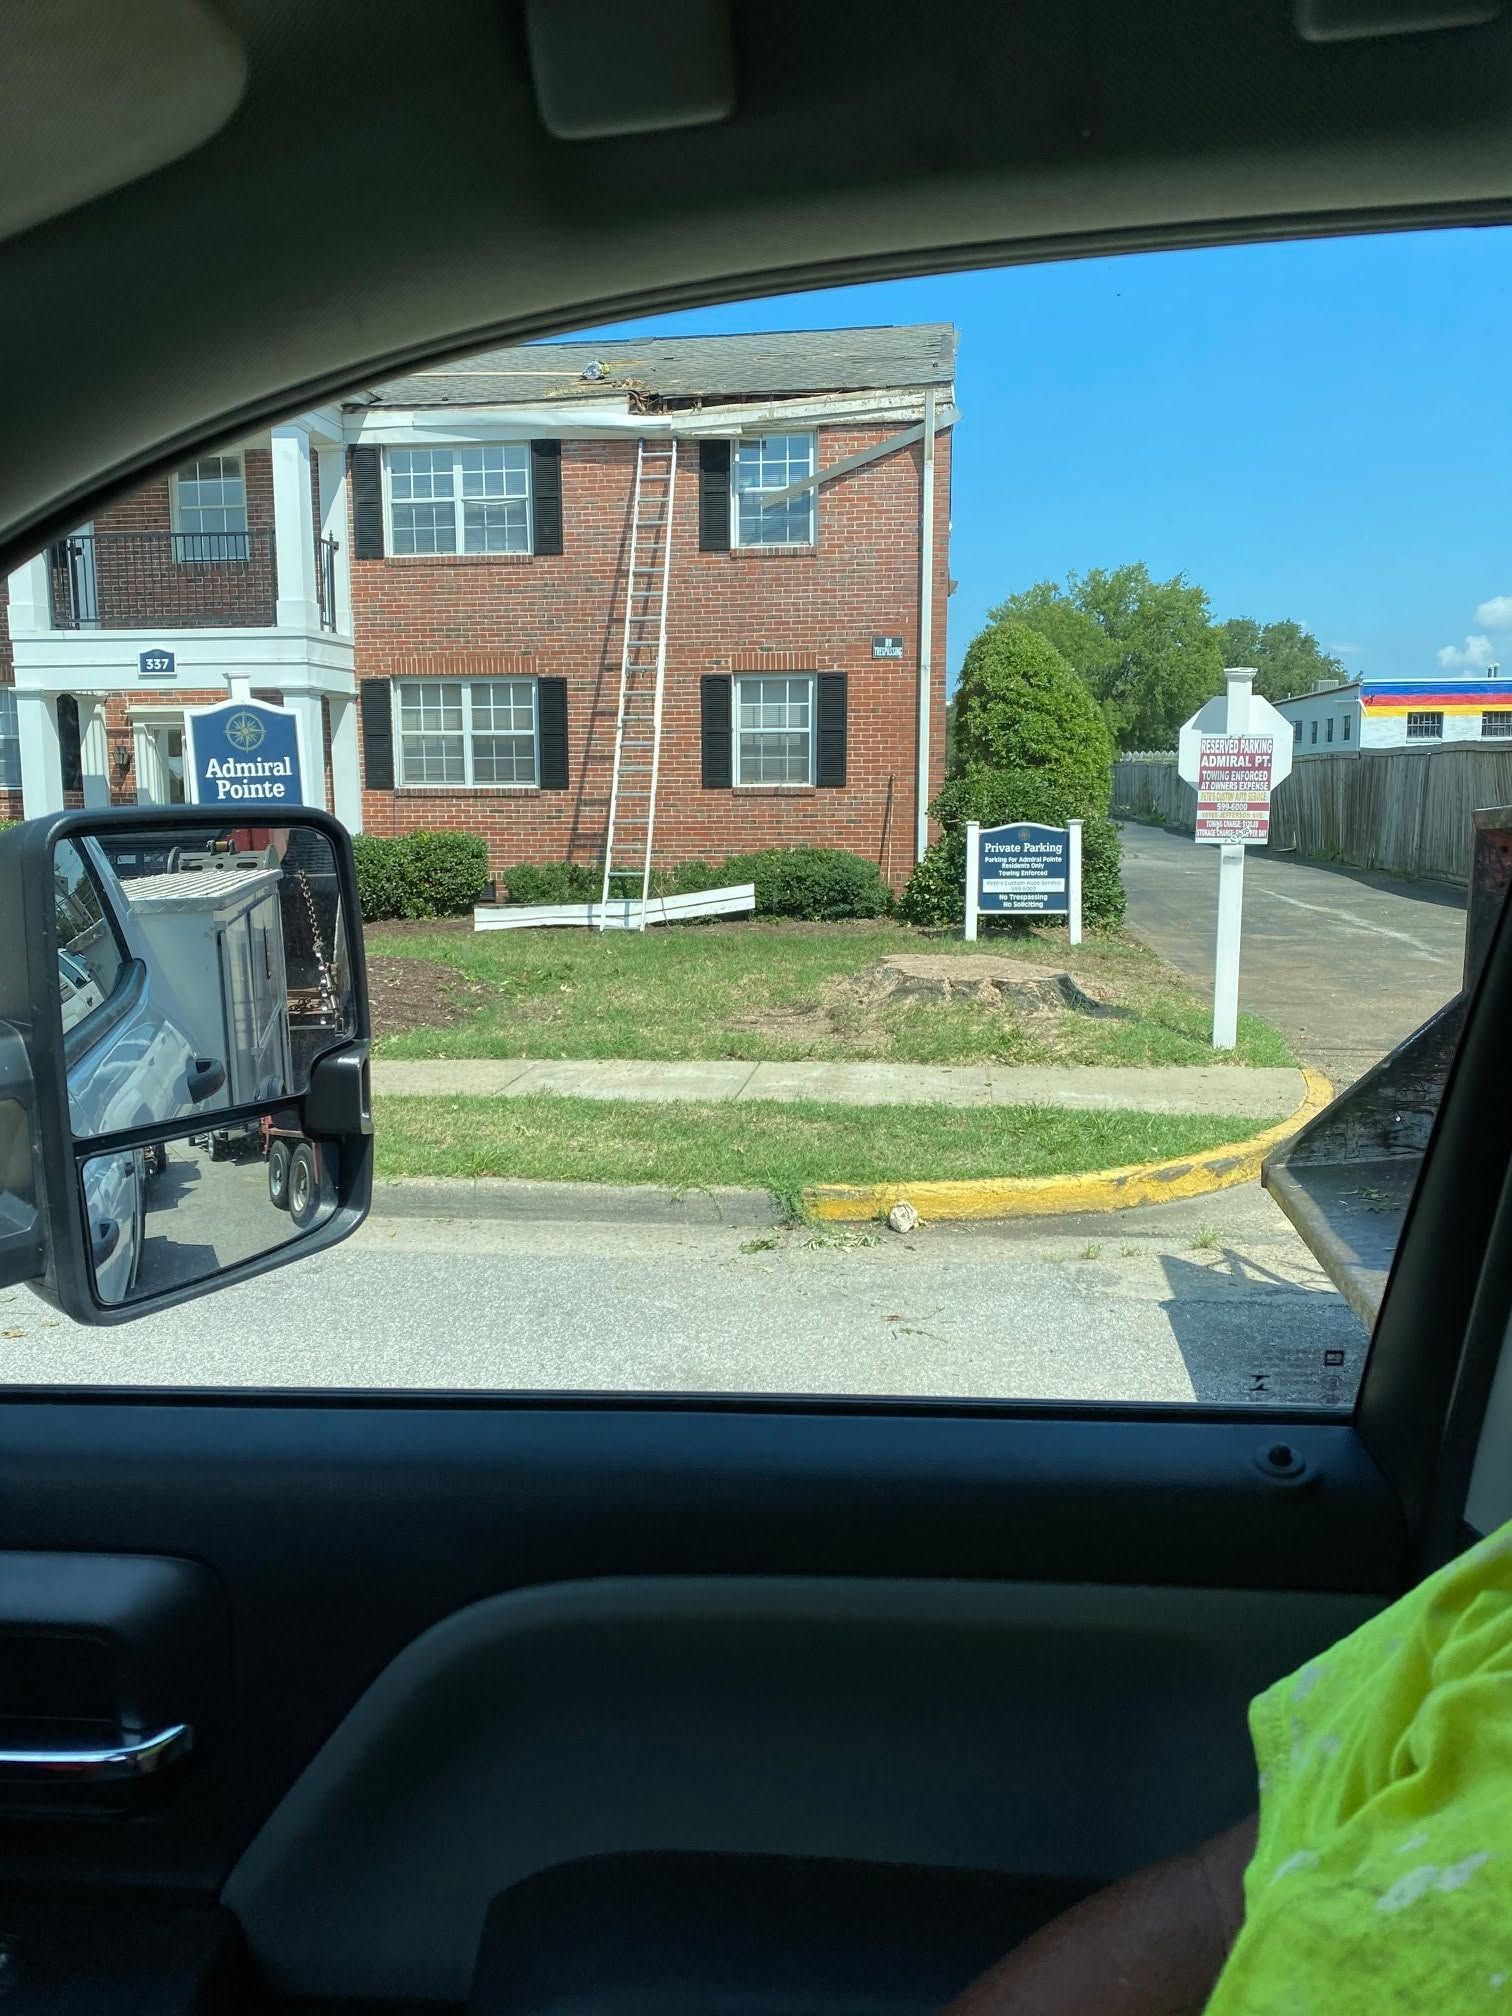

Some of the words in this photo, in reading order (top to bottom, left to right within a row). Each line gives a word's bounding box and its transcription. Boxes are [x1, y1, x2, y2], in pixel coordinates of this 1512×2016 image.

[145, 658, 169, 670] 337
[1201, 739, 1239, 754] RESERVED
[1240, 739, 1273, 754] PARKING
[205, 757, 292, 778] Admiral
[1201, 755, 1252, 768] ADMIRAL
[1255, 755, 1271, 767] PT.
[1202, 770, 1230, 781] TOWING
[1231, 770, 1268, 781] ENFORCED
[216, 779, 285, 800] Pointe
[1201, 781, 1210, 790] AT
[1210, 781, 1238, 790] OWNERS
[1239, 781, 1269, 790] EXPENSE
[984, 842, 1021, 853] Private
[1023, 842, 1063, 855] Parking
[984, 856, 1008, 864] Parking
